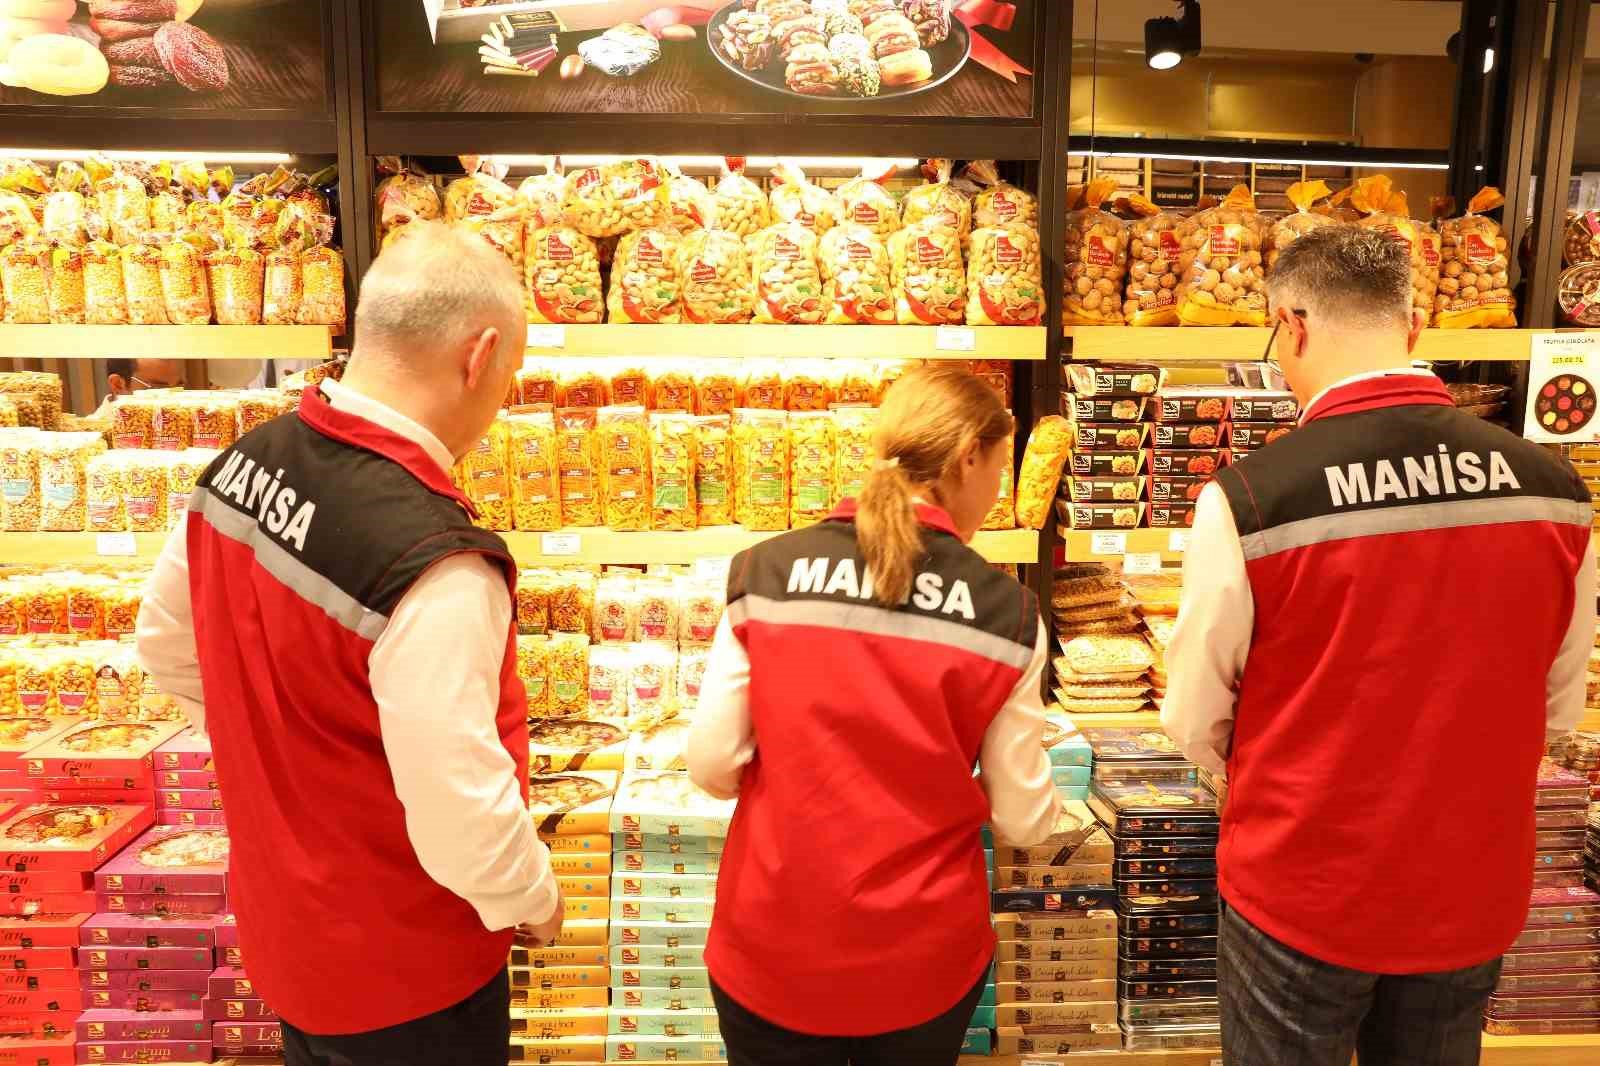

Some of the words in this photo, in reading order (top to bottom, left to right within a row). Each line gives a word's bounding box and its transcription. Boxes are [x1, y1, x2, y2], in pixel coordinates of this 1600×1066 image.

[210, 449, 317, 552] MANİSA
[1323, 443, 1522, 507] MANİSA
[786, 556, 976, 620] MASA
[6, 853, 40, 867] Can
